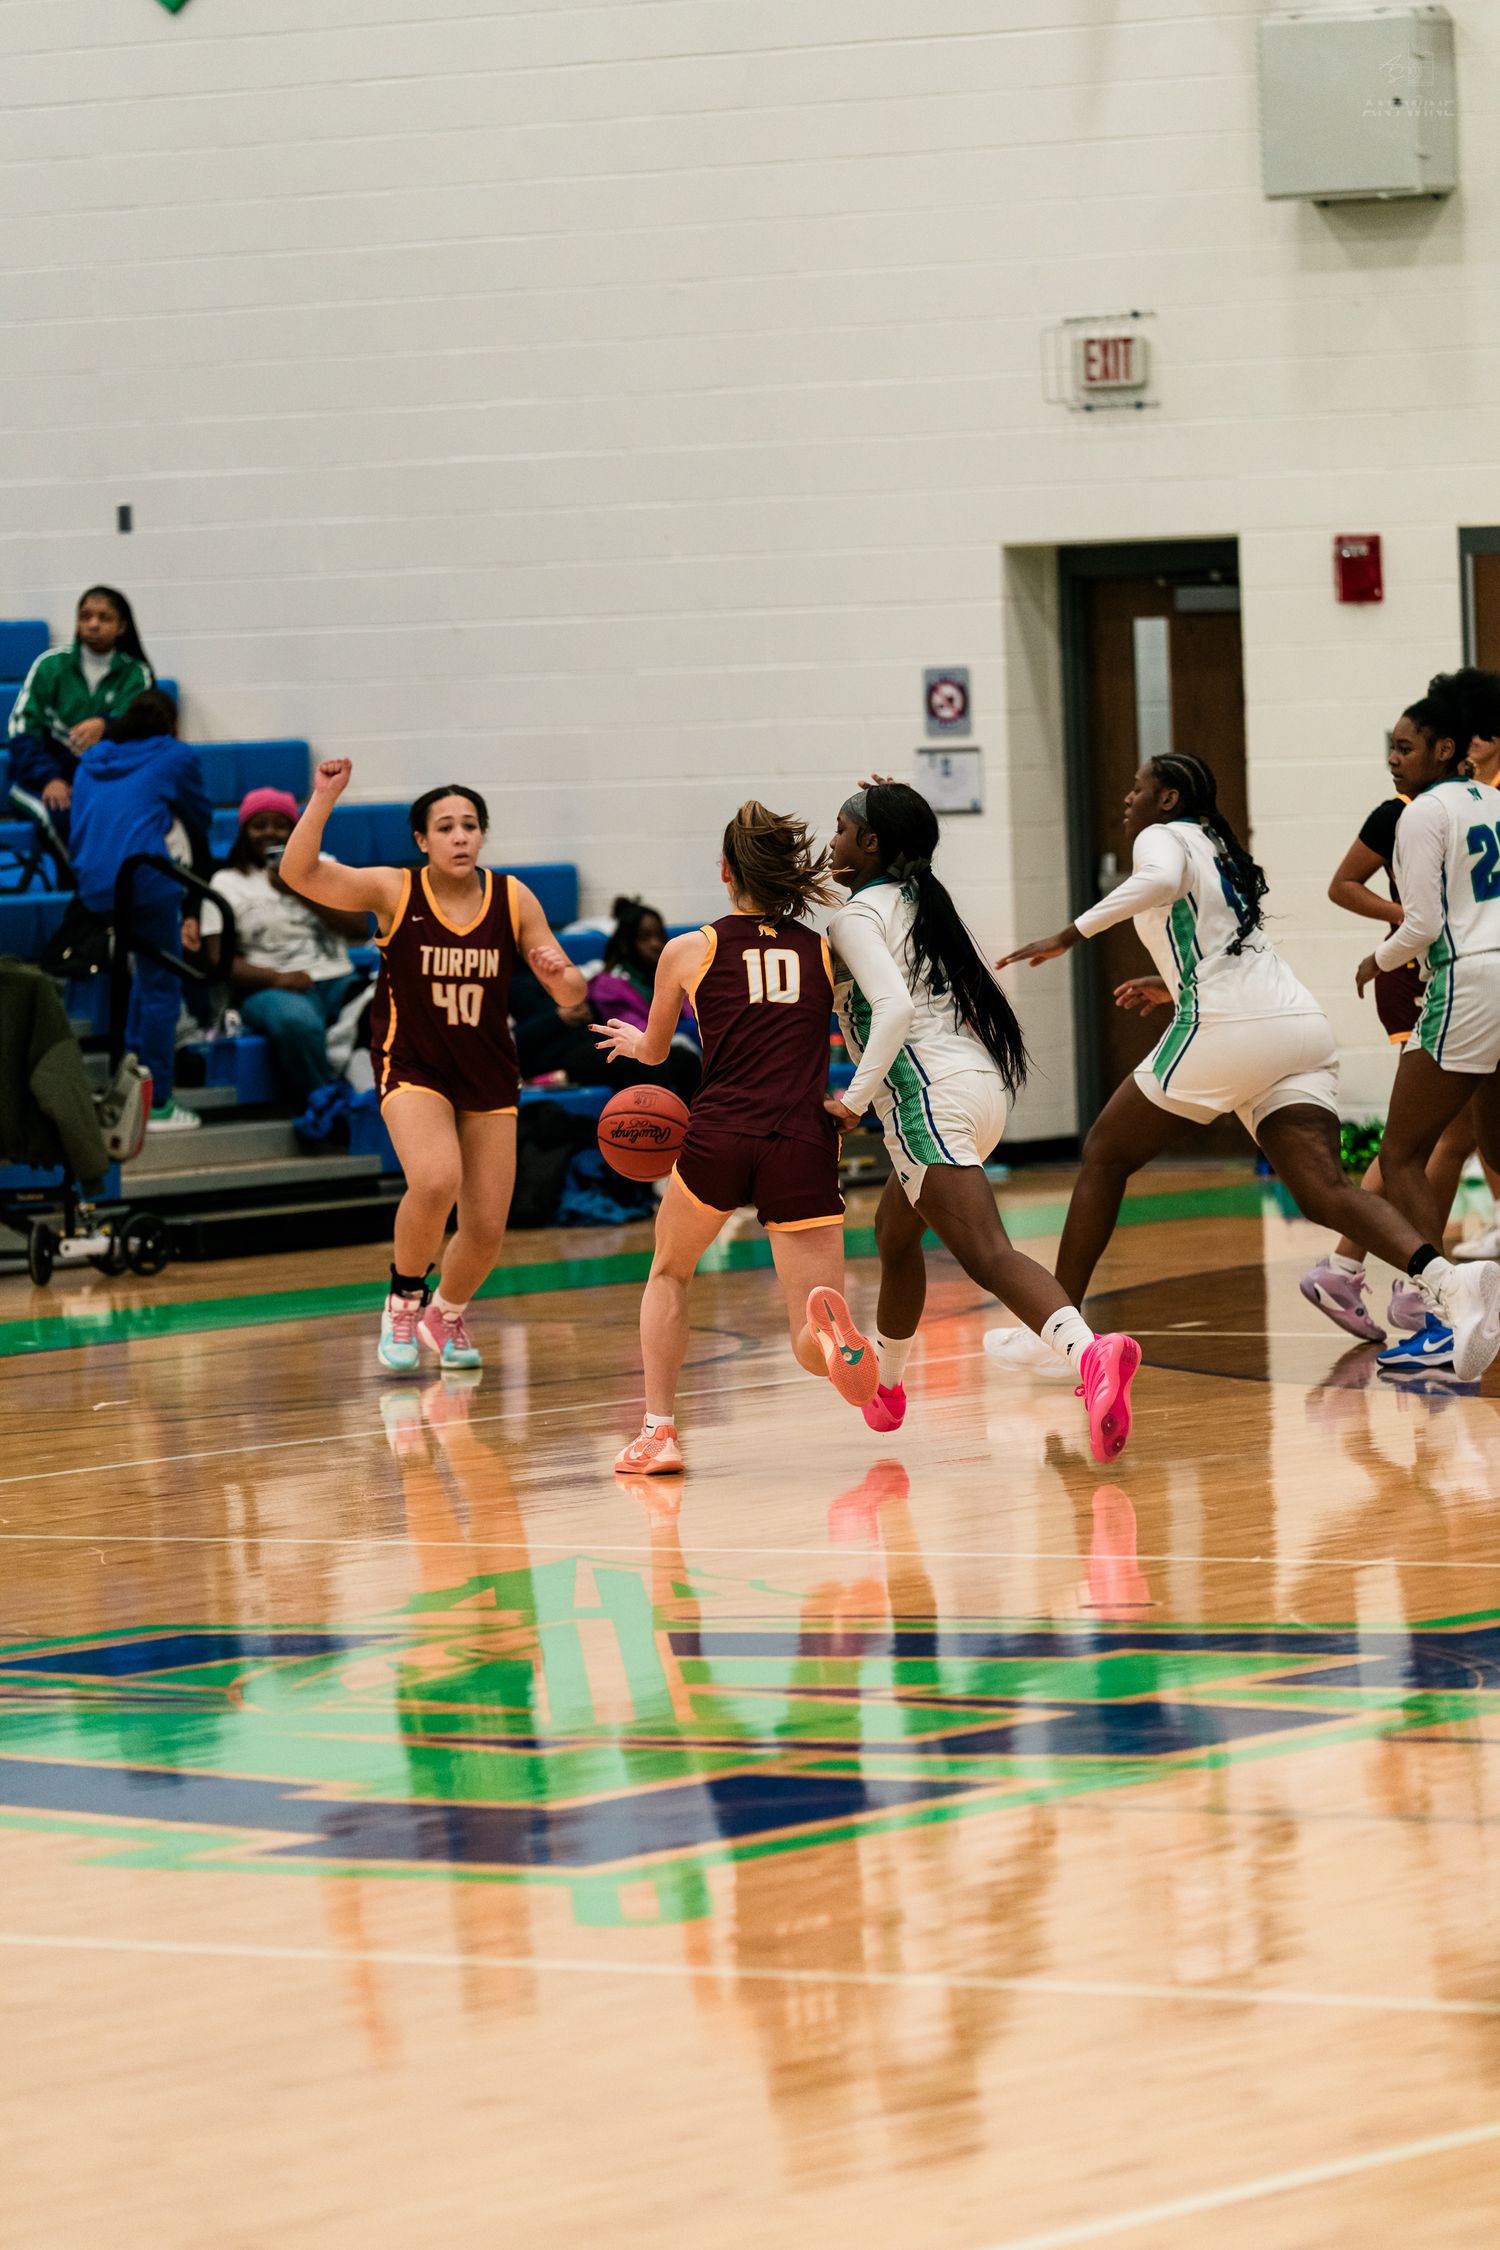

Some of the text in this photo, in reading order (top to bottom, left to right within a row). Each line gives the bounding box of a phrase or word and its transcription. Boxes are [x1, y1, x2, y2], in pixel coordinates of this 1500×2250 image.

[1083, 337, 1133, 382] EXIT
[1467, 821, 1500, 903] 2
[420, 945, 499, 978] TURPIN
[742, 948, 800, 1004] 10
[431, 982, 484, 1027] 40
[611, 1121, 671, 1144] Rawlings
